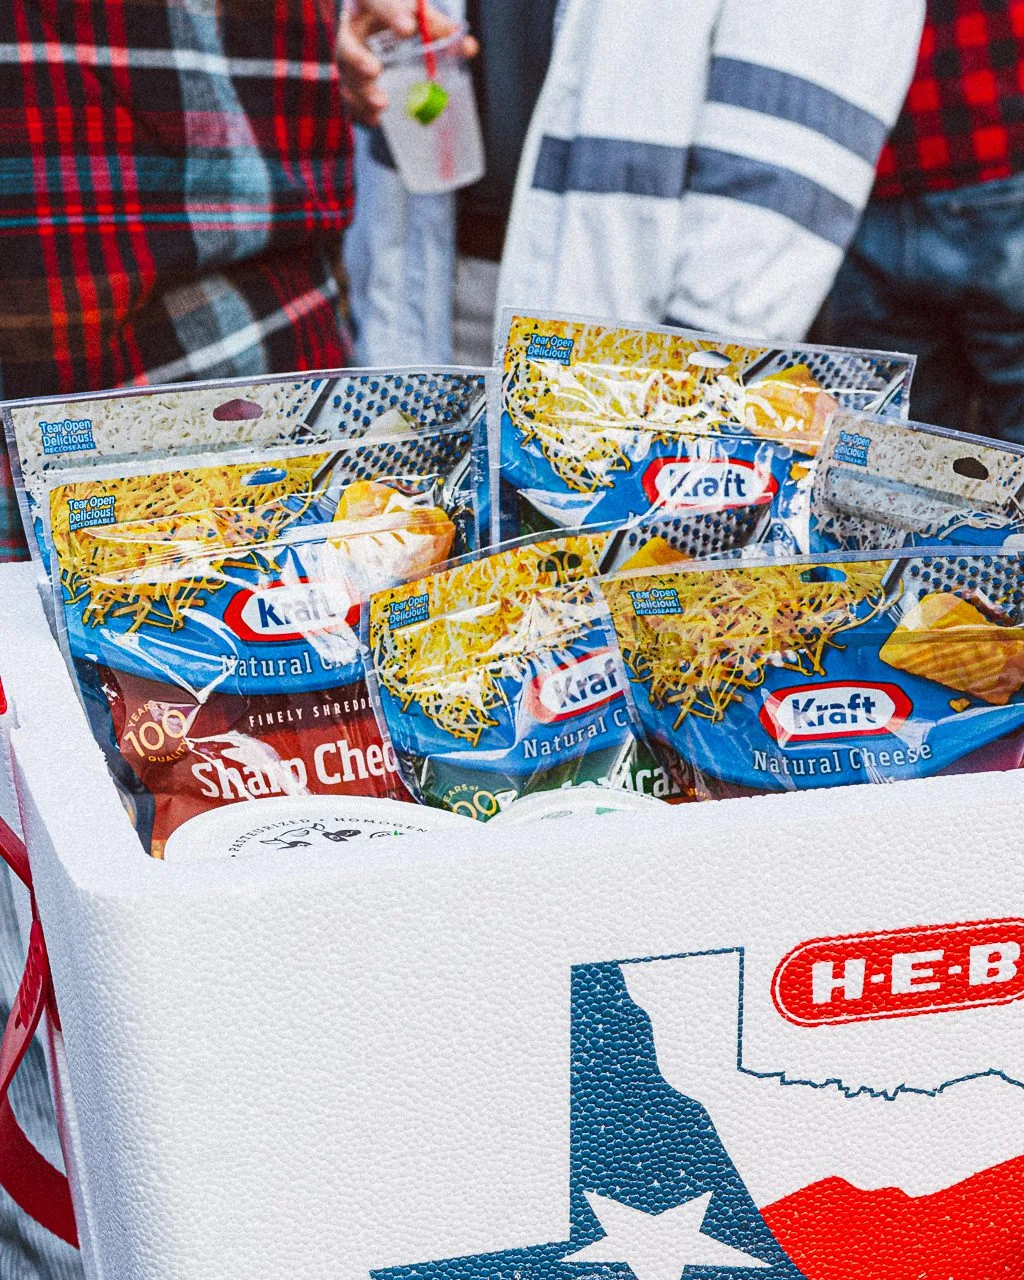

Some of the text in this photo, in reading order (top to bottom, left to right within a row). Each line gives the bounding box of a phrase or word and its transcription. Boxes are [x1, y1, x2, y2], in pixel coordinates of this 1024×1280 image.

[531, 334, 574, 347] Tear Open
[528, 345, 571, 358] Delicious!
[40, 420, 91, 434] Tear Open
[42, 433, 93, 447] Delicious!
[44, 443, 95, 454] RECLOSEABLE
[669, 469, 746, 497] Kraft
[68, 496, 115, 511] Tear Open
[69, 507, 114, 524] Delicious!
[70, 517, 116, 531] RECLOSEABLE
[390, 594, 428, 613] Tear Open
[629, 588, 677, 600] Tear Open
[389, 603, 428, 624] Delicious!
[632, 598, 680, 610] Delicious!
[221, 651, 313, 677] Natural
[248, 711, 304, 729] FINELY
[791, 693, 877, 729] Kraft
[123, 708, 189, 759] 100
[523, 721, 606, 759] Natural
[147, 737, 189, 764] QUALITY
[753, 744, 932, 776] Natural Cheese
[191, 756, 309, 800] Sharp
[452, 790, 498, 820] 00
[228, 818, 311, 852] PASTEURIZED
